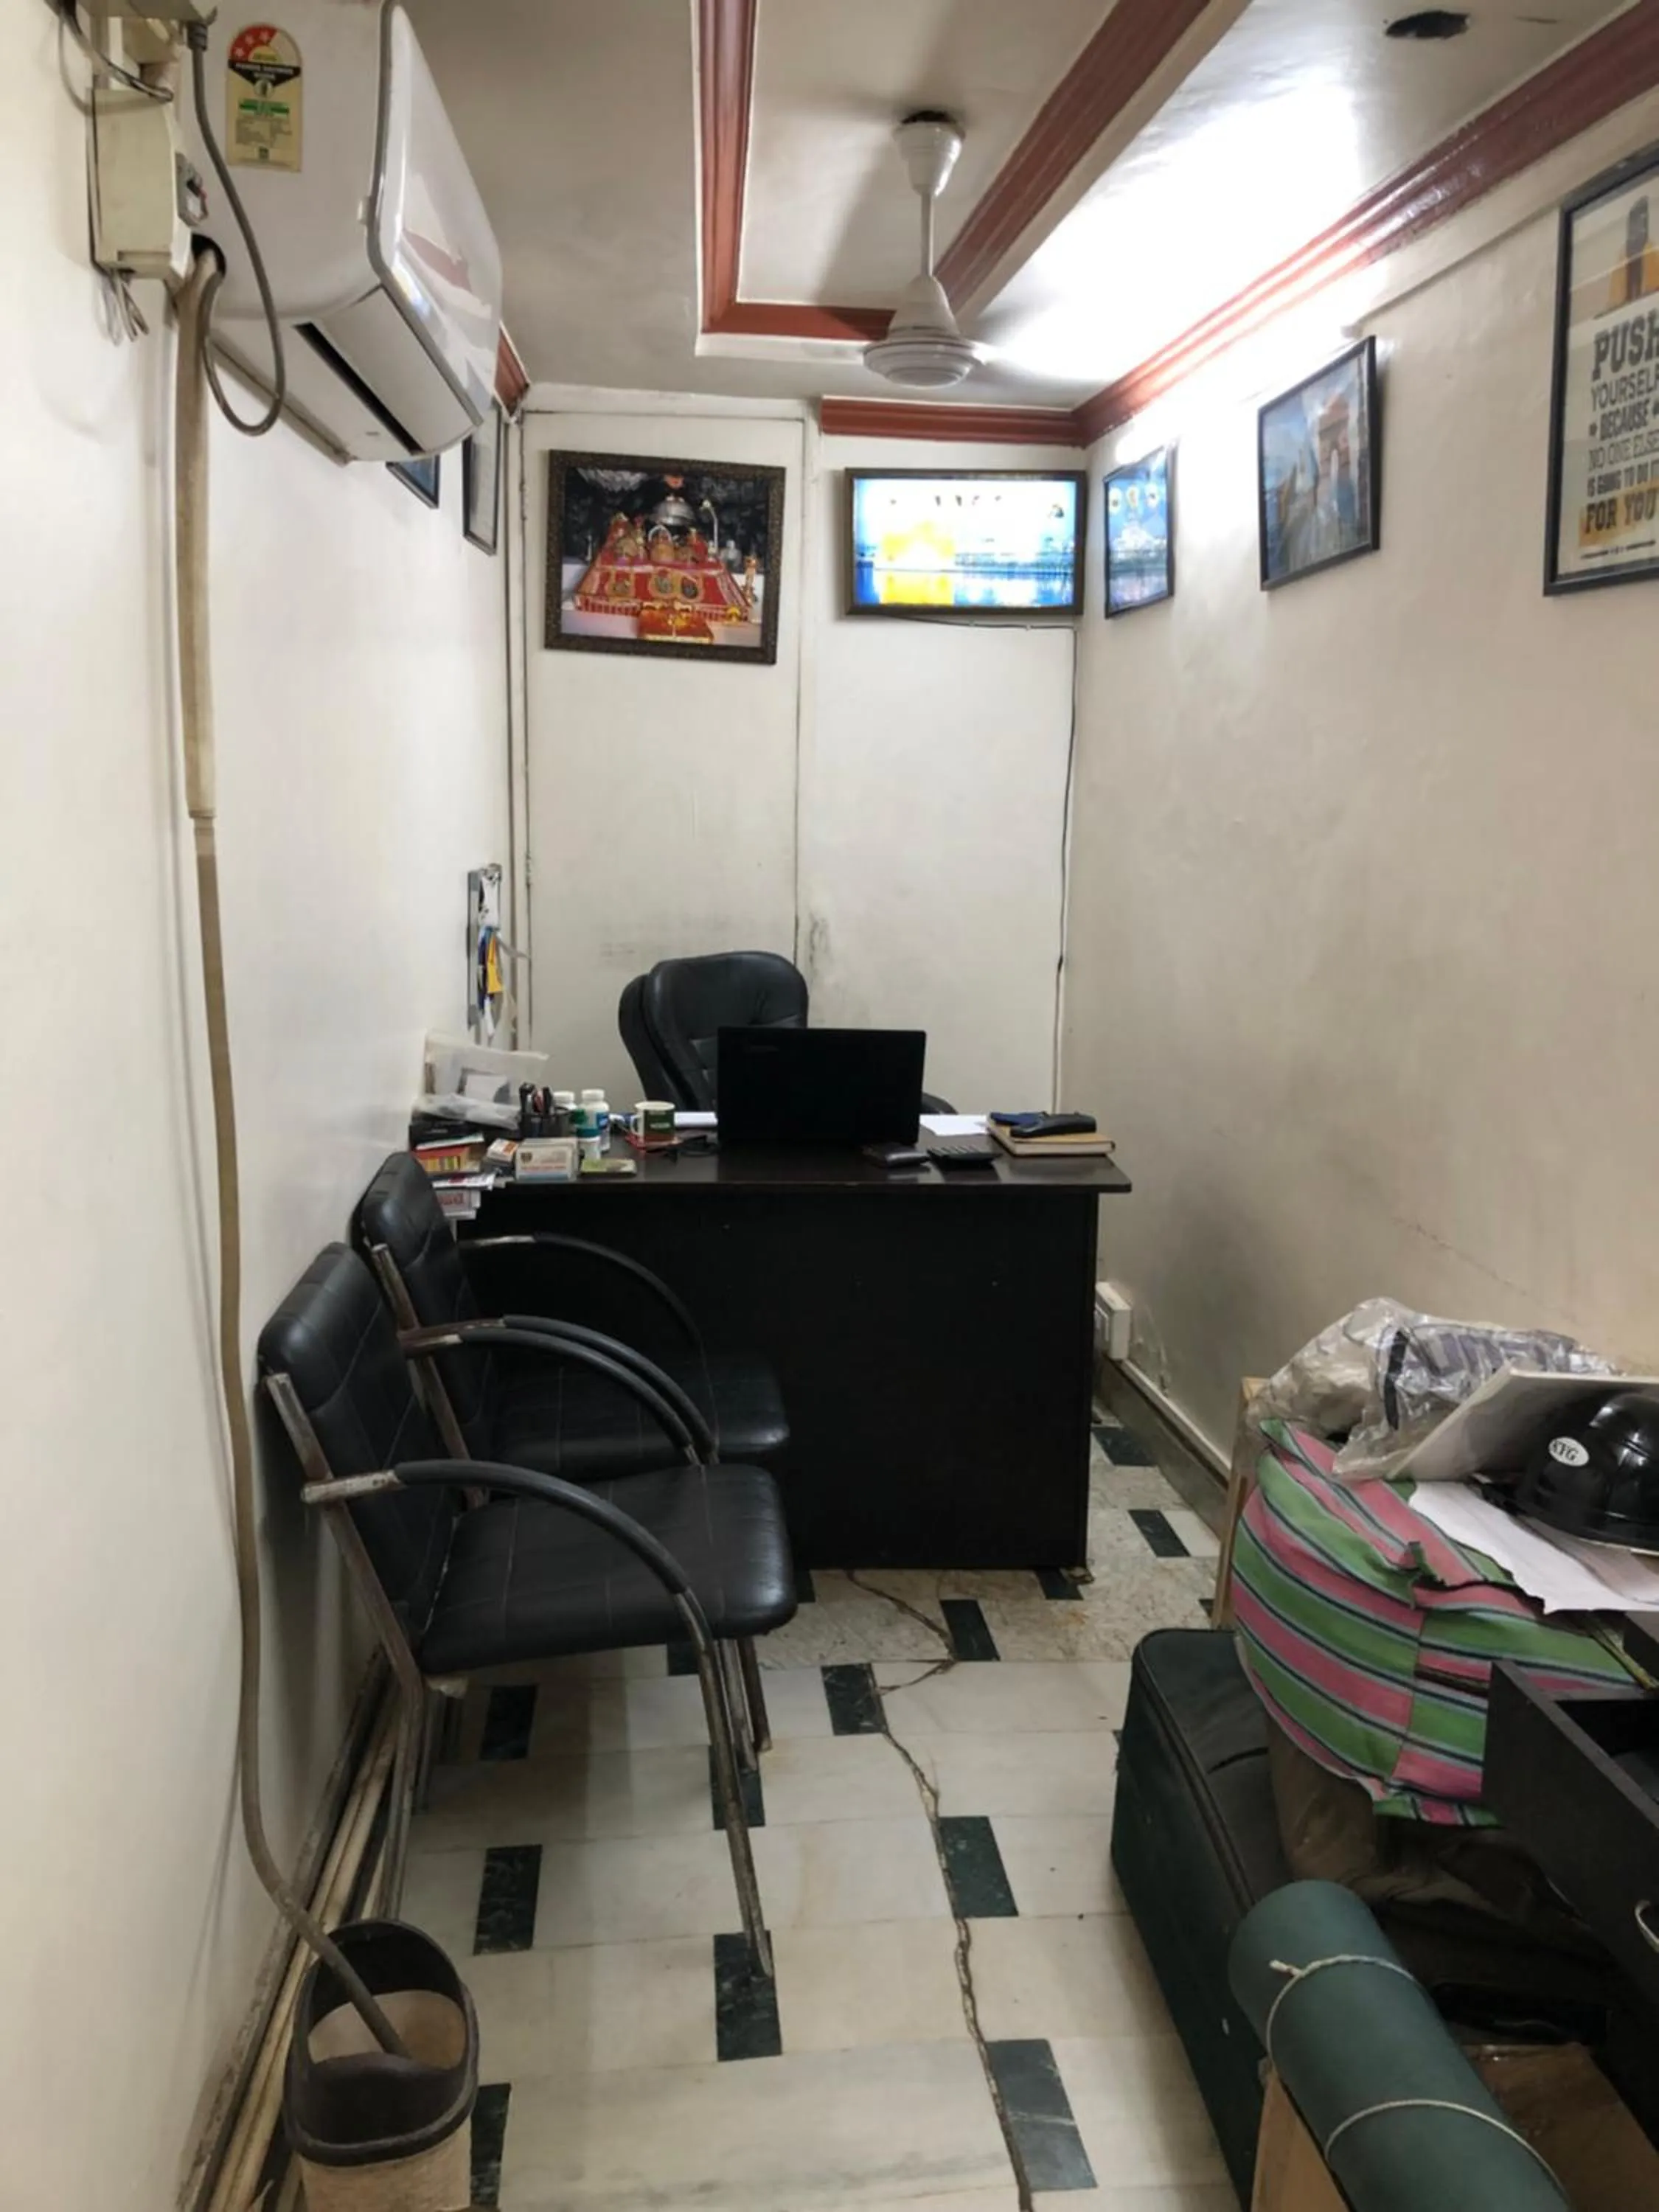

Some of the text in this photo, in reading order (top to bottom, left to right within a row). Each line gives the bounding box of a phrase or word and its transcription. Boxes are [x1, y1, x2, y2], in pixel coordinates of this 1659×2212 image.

[1600, 398, 1649, 441] BECAUSE
[1588, 446, 1605, 471] NO
[1608, 437, 1631, 465] ONE
[1585, 488, 1656, 534] FOR YOU
